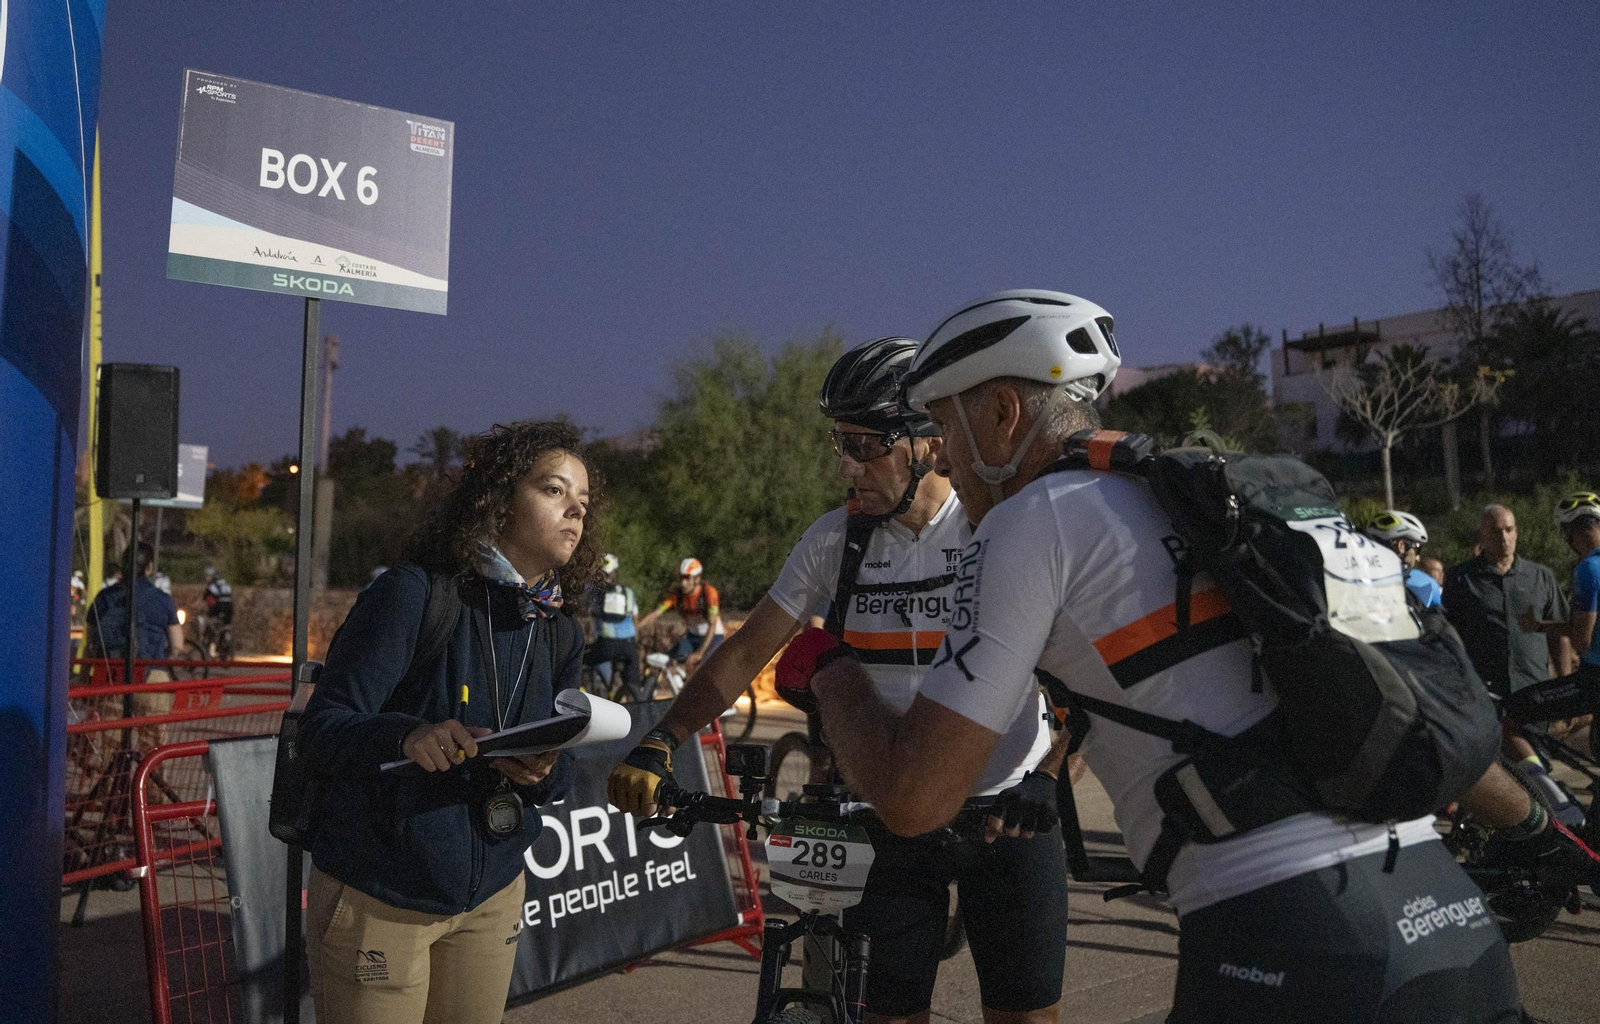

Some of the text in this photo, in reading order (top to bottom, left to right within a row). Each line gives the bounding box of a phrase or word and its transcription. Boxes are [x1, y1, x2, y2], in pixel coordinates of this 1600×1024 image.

[206, 84, 224, 93] RPM
[206, 89, 236, 100] SPORTS
[406, 120, 446, 141] TITAN
[410, 135, 445, 148] DESERT
[259, 147, 379, 206] BOX 6
[346, 267, 378, 278] ALMERÍA
[864, 560, 891, 569] mobel
[1343, 554, 1382, 570] JAME
[791, 840, 847, 870] 289
[799, 870, 838, 883] CARLES
[549, 869, 639, 929] people
[645, 851, 696, 892] feel
[1403, 895, 1438, 919] cicles
[1396, 896, 1486, 945] Berenguer
[1218, 962, 1286, 988] mobel
